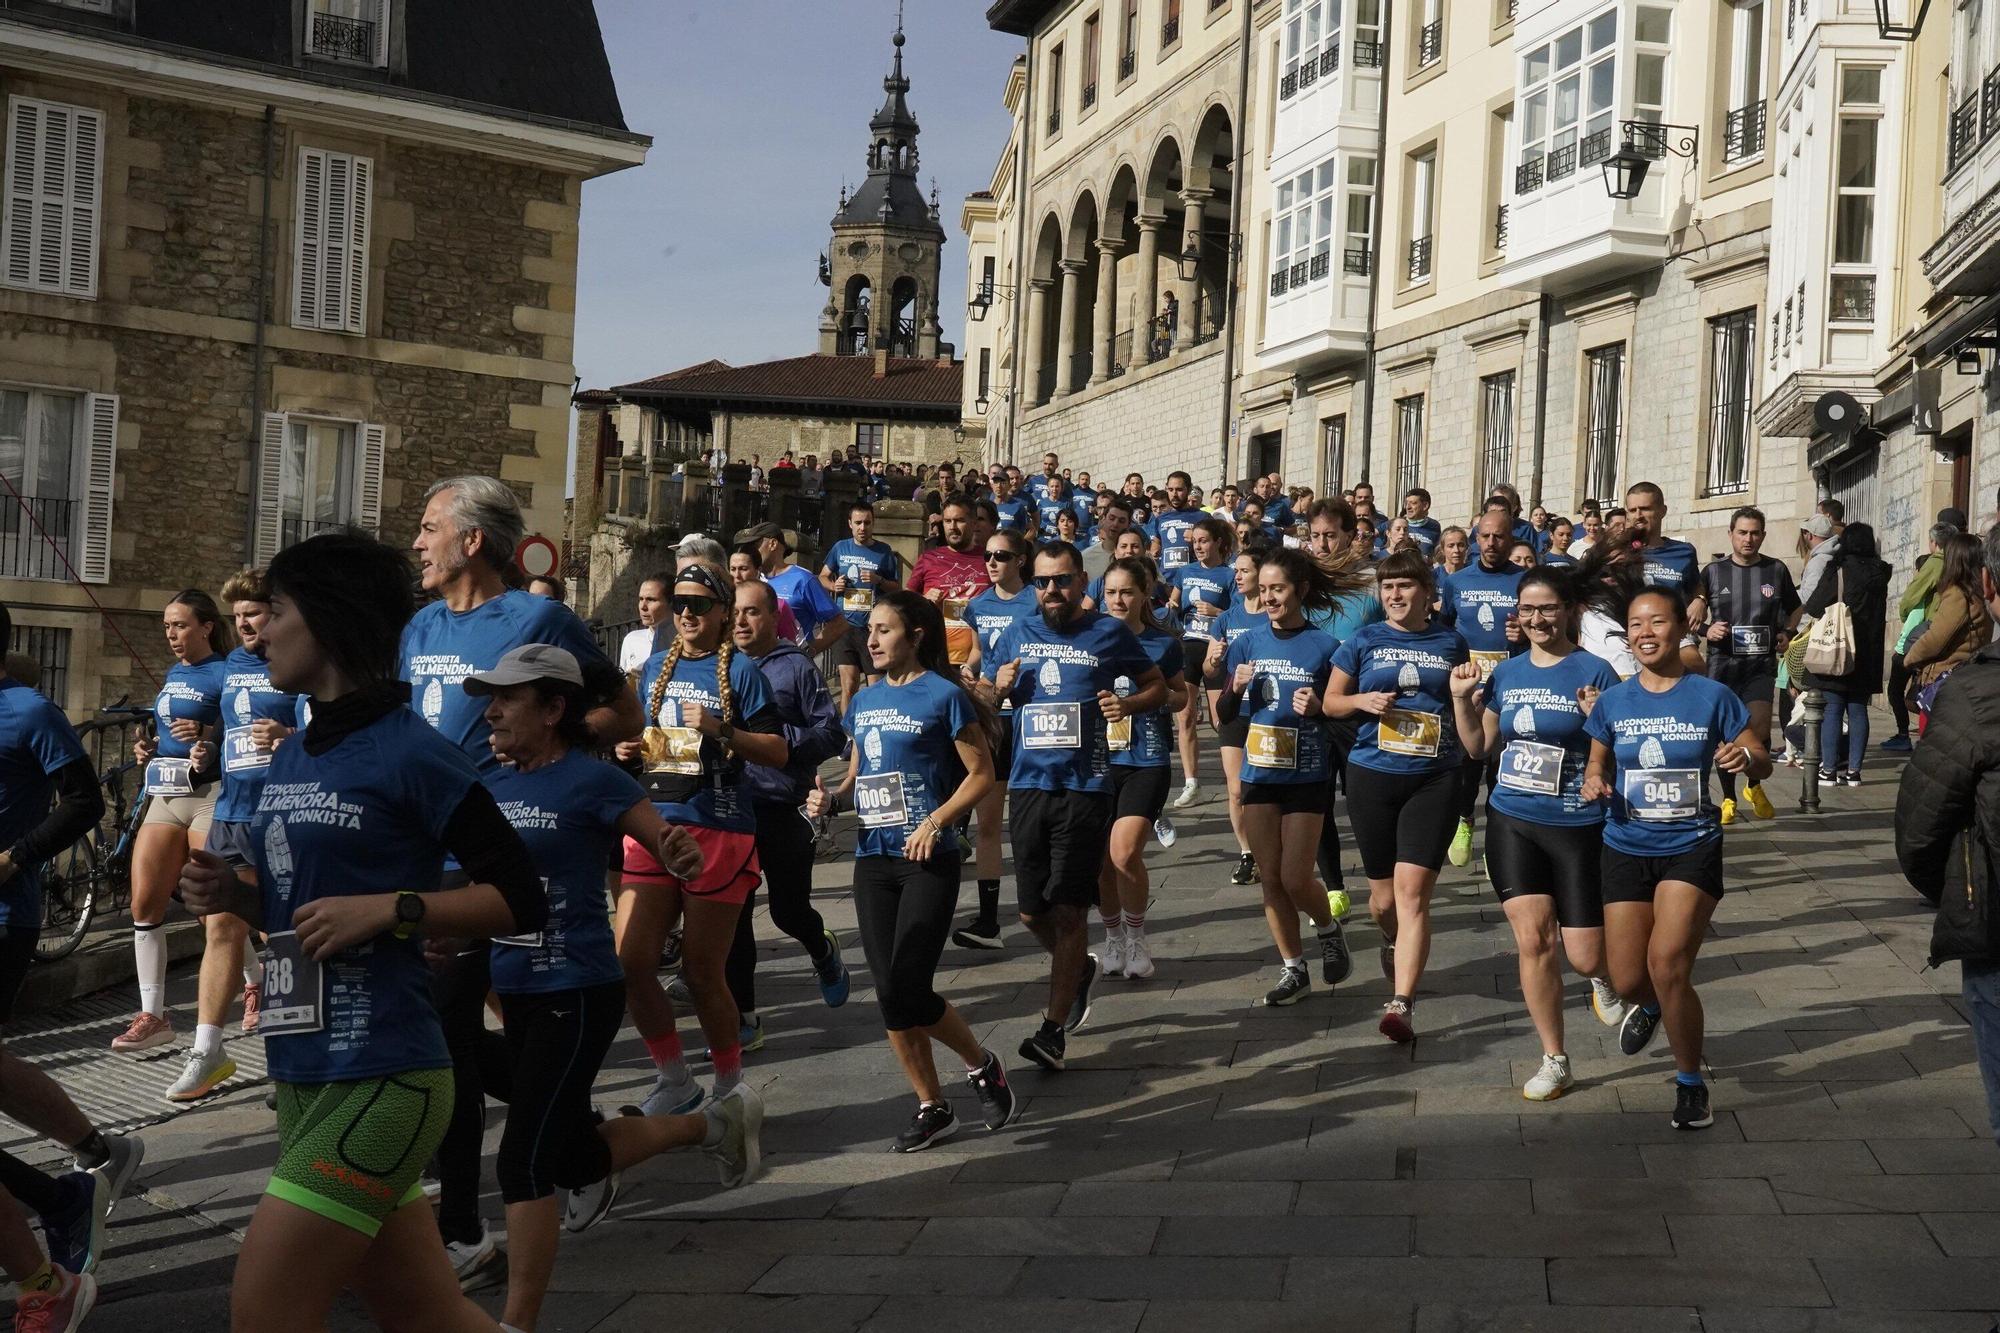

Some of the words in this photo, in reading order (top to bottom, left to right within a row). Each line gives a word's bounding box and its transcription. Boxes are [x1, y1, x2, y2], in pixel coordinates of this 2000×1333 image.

[1942, 452, 1948, 462] 2
[1743, 633, 1761, 644] 927
[1029, 643, 1073, 651] CONQUISTA
[1383, 648, 1429, 656] CONQUISTA
[1029, 648, 1089, 658] ALMENDRA
[1385, 653, 1444, 663] ALMENDRA
[416, 655, 460, 664] CONQUISTA
[1059, 657, 1099, 668] KONKISTA
[415, 664, 474, 675] ALMENDRA
[1254, 665, 1305, 675] ALMENDRA
[1279, 674, 1314, 683] KONKISTA
[1507, 694, 1567, 705] ALMENDRA
[860, 708, 898, 718] CONQUISTA
[1535, 703, 1579, 714] KONKISTA
[857, 715, 911, 727] ALMENDRA
[1032, 714, 1068, 732] 1032
[1623, 716, 1676, 726] CONQUISTA
[881, 723, 922, 735] KONKISTA
[1625, 722, 1696, 737] ALMENDRA
[1662, 732, 1708, 741] KONKISTA
[1260, 735, 1278, 752] 43
[1513, 753, 1543, 775] 822
[158, 767, 176, 783] 787
[857, 787, 892, 809] 1006
[1644, 782, 1681, 803] 945
[339, 802, 364, 815] REN
[288, 809, 361, 830] KONKISTA
[540, 811, 558, 820] REN
[264, 957, 294, 997] 738
